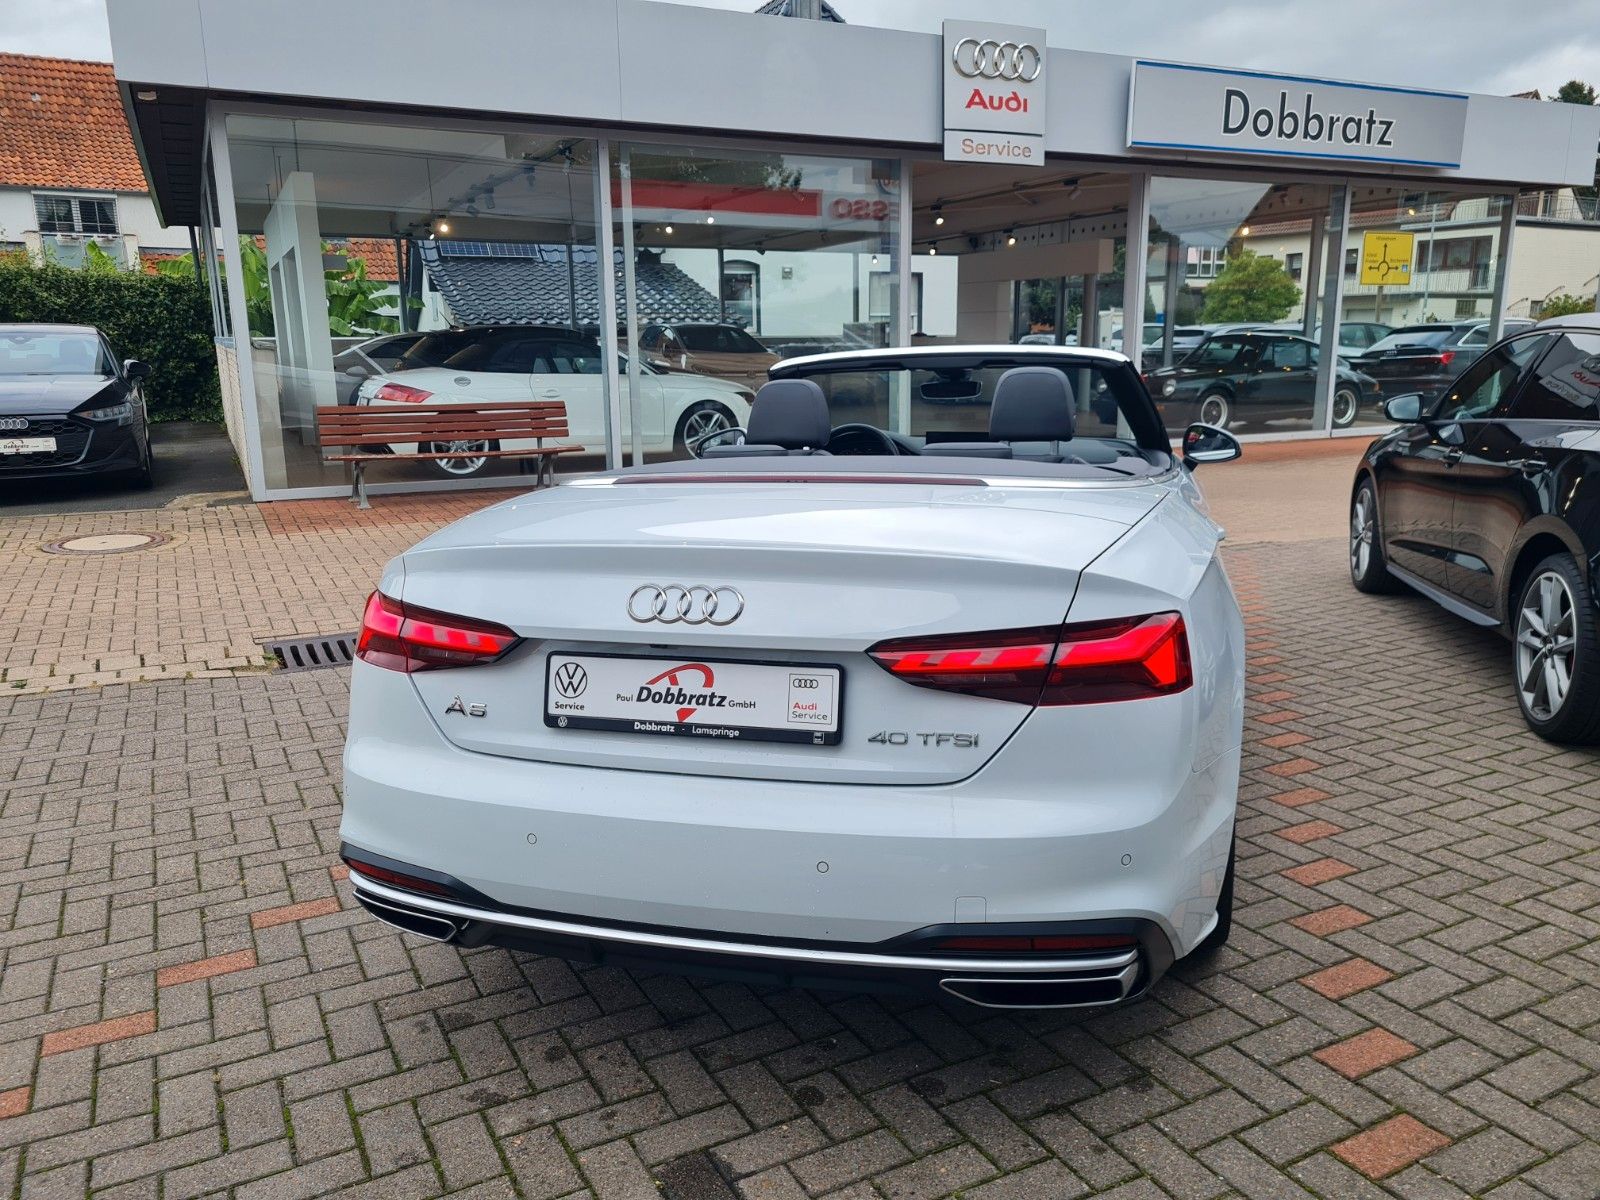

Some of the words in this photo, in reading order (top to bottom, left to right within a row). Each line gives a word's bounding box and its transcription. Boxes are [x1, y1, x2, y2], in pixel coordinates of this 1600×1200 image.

[965, 89, 1028, 112] Audi
[1222, 88, 1394, 147] Dobbratz
[961, 138, 1032, 158] Service
[445, 695, 487, 717] A5
[554, 701, 585, 711] Service
[616, 693, 634, 702] Paul
[636, 686, 728, 708] Dobbratz
[728, 700, 756, 709] GmbH
[793, 702, 817, 711] Audi
[791, 710, 828, 721] Service
[634, 721, 675, 733] Dobbratz
[692, 725, 740, 737] Lamspringe
[867, 731, 908, 745] 40
[916, 732, 979, 747] TFSI
